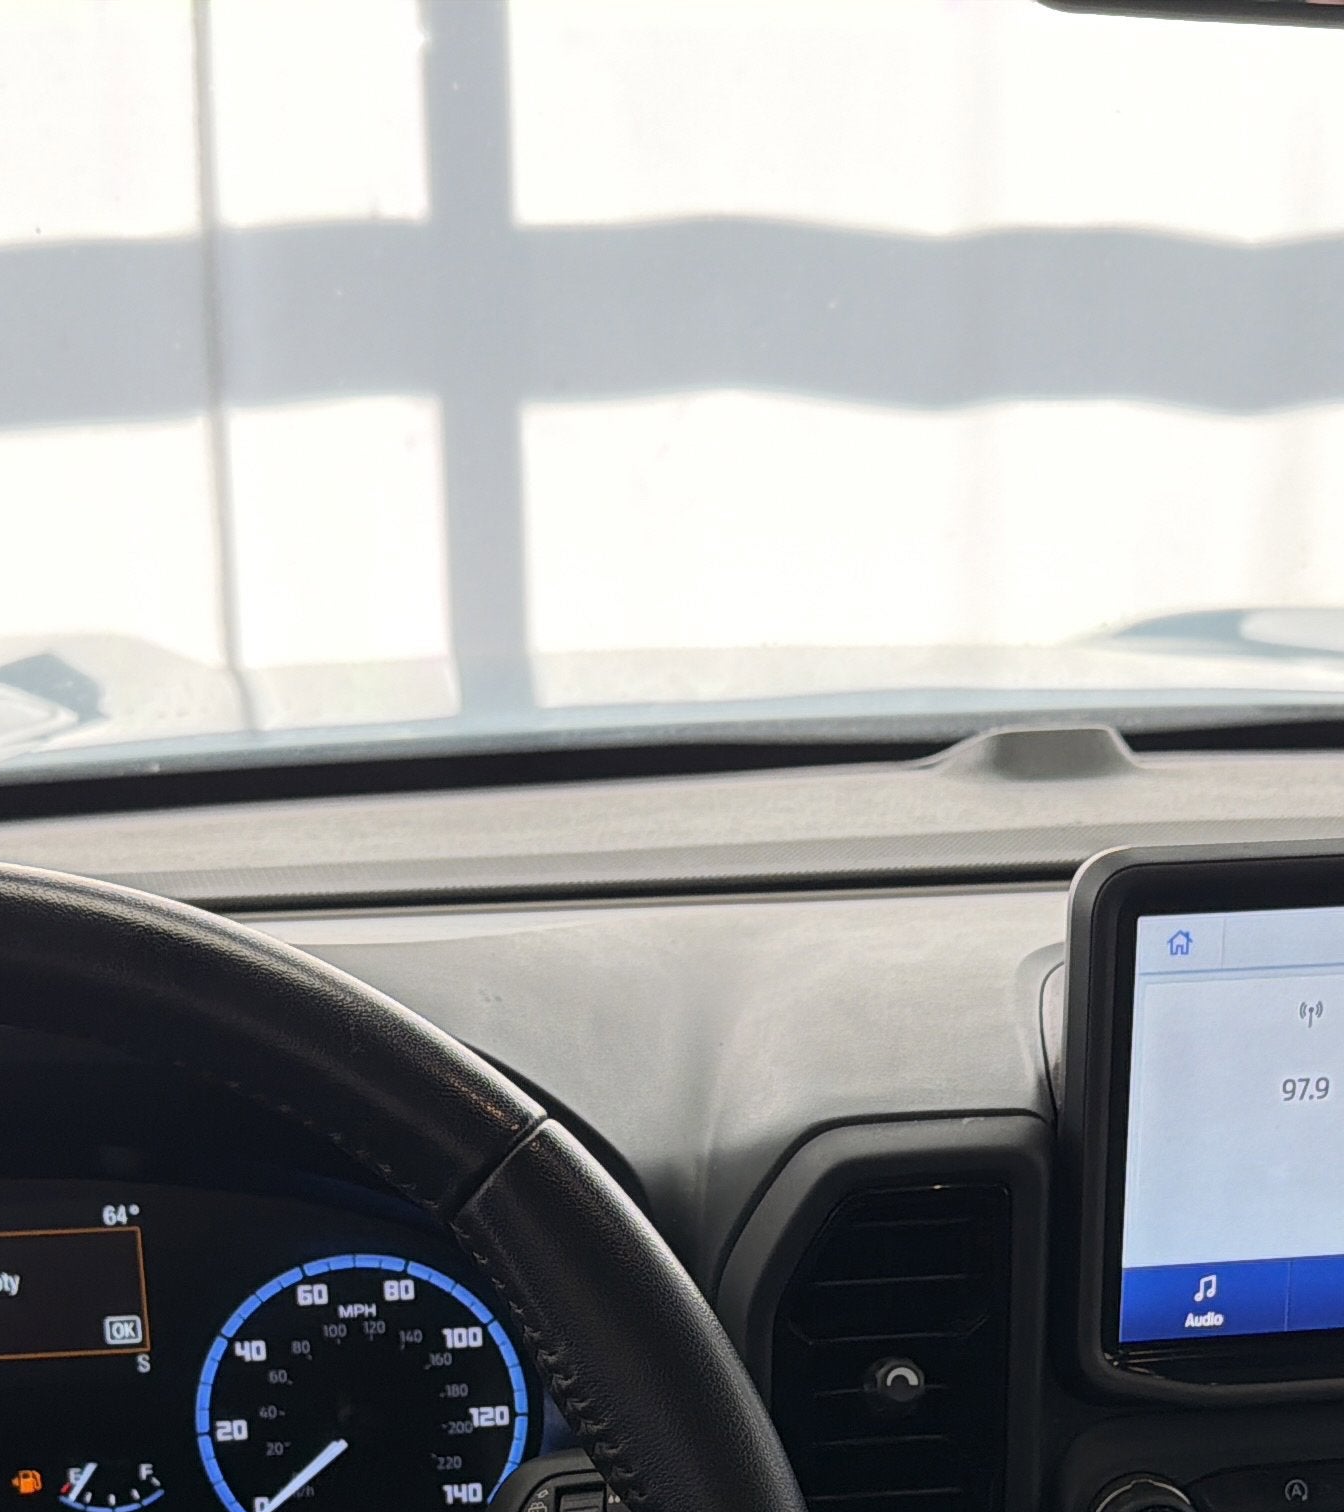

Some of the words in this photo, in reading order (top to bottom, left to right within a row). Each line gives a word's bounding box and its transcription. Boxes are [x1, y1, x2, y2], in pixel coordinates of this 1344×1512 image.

[1282, 1075, 1330, 1103] 97.9
[102, 1204, 140, 1226] 64°
[297, 1284, 328, 1306] 60
[384, 1279, 415, 1301] 80
[338, 1303, 377, 1319] MPH
[1185, 1310, 1224, 1329] Audio
[112, 1321, 135, 1339] OK
[323, 1324, 347, 1339] 100
[363, 1320, 386, 1335] 120
[399, 1329, 423, 1344] 140
[442, 1327, 483, 1349] 100
[234, 1340, 266, 1362] 40
[291, 1341, 311, 1355] 80
[137, 1354, 151, 1373] S
[430, 1353, 453, 1367] 160
[269, 1370, 288, 1384] 60
[445, 1384, 469, 1397] 180
[259, 1406, 278, 1420] 40
[469, 1405, 510, 1428] 120
[216, 1420, 248, 1442] 20
[447, 1421, 473, 1435] 200
[266, 1442, 284, 1456] 20
[139, 1463, 153, 1481] F
[436, 1456, 462, 1470] 220
[442, 1483, 483, 1505] 140
